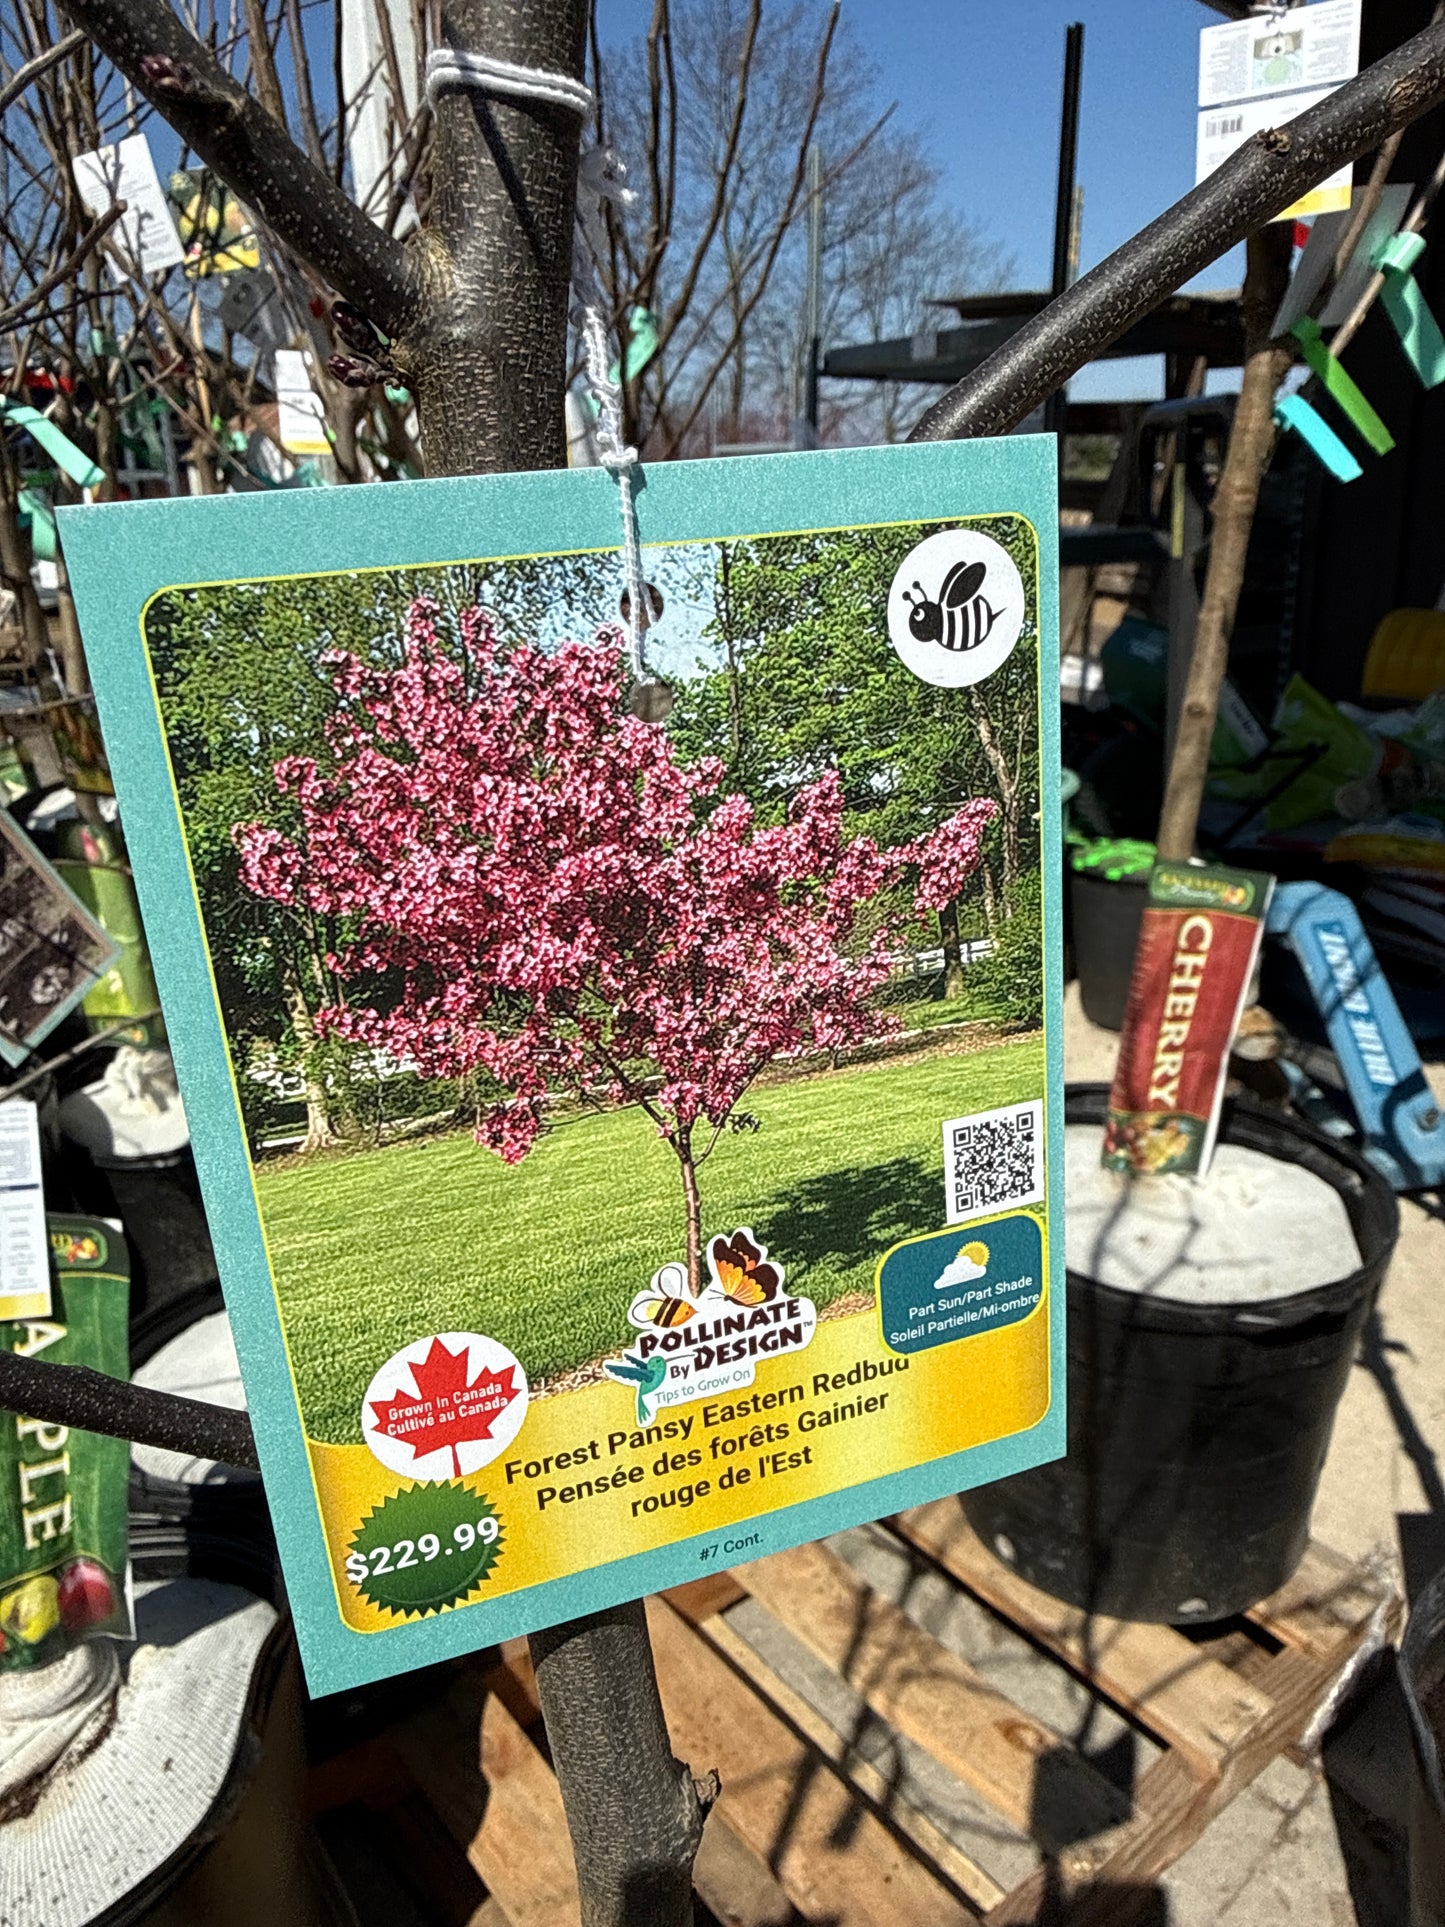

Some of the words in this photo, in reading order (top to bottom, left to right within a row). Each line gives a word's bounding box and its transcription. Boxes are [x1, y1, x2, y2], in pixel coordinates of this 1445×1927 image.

[1149, 914, 1214, 1110] CHERRY
[890, 1324, 925, 1344] Soleil
[928, 1293, 1040, 1334] Partielle/Mi-ombre
[909, 1303, 935, 1320] Part
[938, 1286, 992, 1311] Sun/Part
[995, 1275, 1033, 1295] Shade
[639, 1298, 800, 1359] POLLINATE
[670, 1364, 690, 1380] By
[693, 1322, 803, 1372] DESIGN
[388, 1401, 433, 1420] Grown
[436, 1396, 449, 1409] In
[453, 1383, 502, 1404] Canada
[655, 1389, 680, 1404] Tips
[682, 1384, 695, 1397] to
[698, 1375, 730, 1391] Grow
[733, 1369, 751, 1382] On
[13, 1320, 73, 1551] APLE
[387, 1412, 435, 1436] Cultivé
[439, 1409, 456, 1423] au
[458, 1397, 508, 1418] Canada
[505, 1440, 600, 1484] Forest
[608, 1415, 694, 1455] Pansy
[702, 1384, 805, 1428] Eastern
[537, 1464, 645, 1511] Pensée
[652, 1448, 702, 1476] des
[709, 1422, 790, 1460] forêts
[798, 1392, 889, 1432] Gainier
[631, 1480, 711, 1518] rouge
[718, 1466, 752, 1490] de
[759, 1446, 813, 1478] l'Est
[345, 1516, 499, 1584] $229.99
[699, 1545, 719, 1561] #7
[723, 1532, 764, 1554] Cont.
